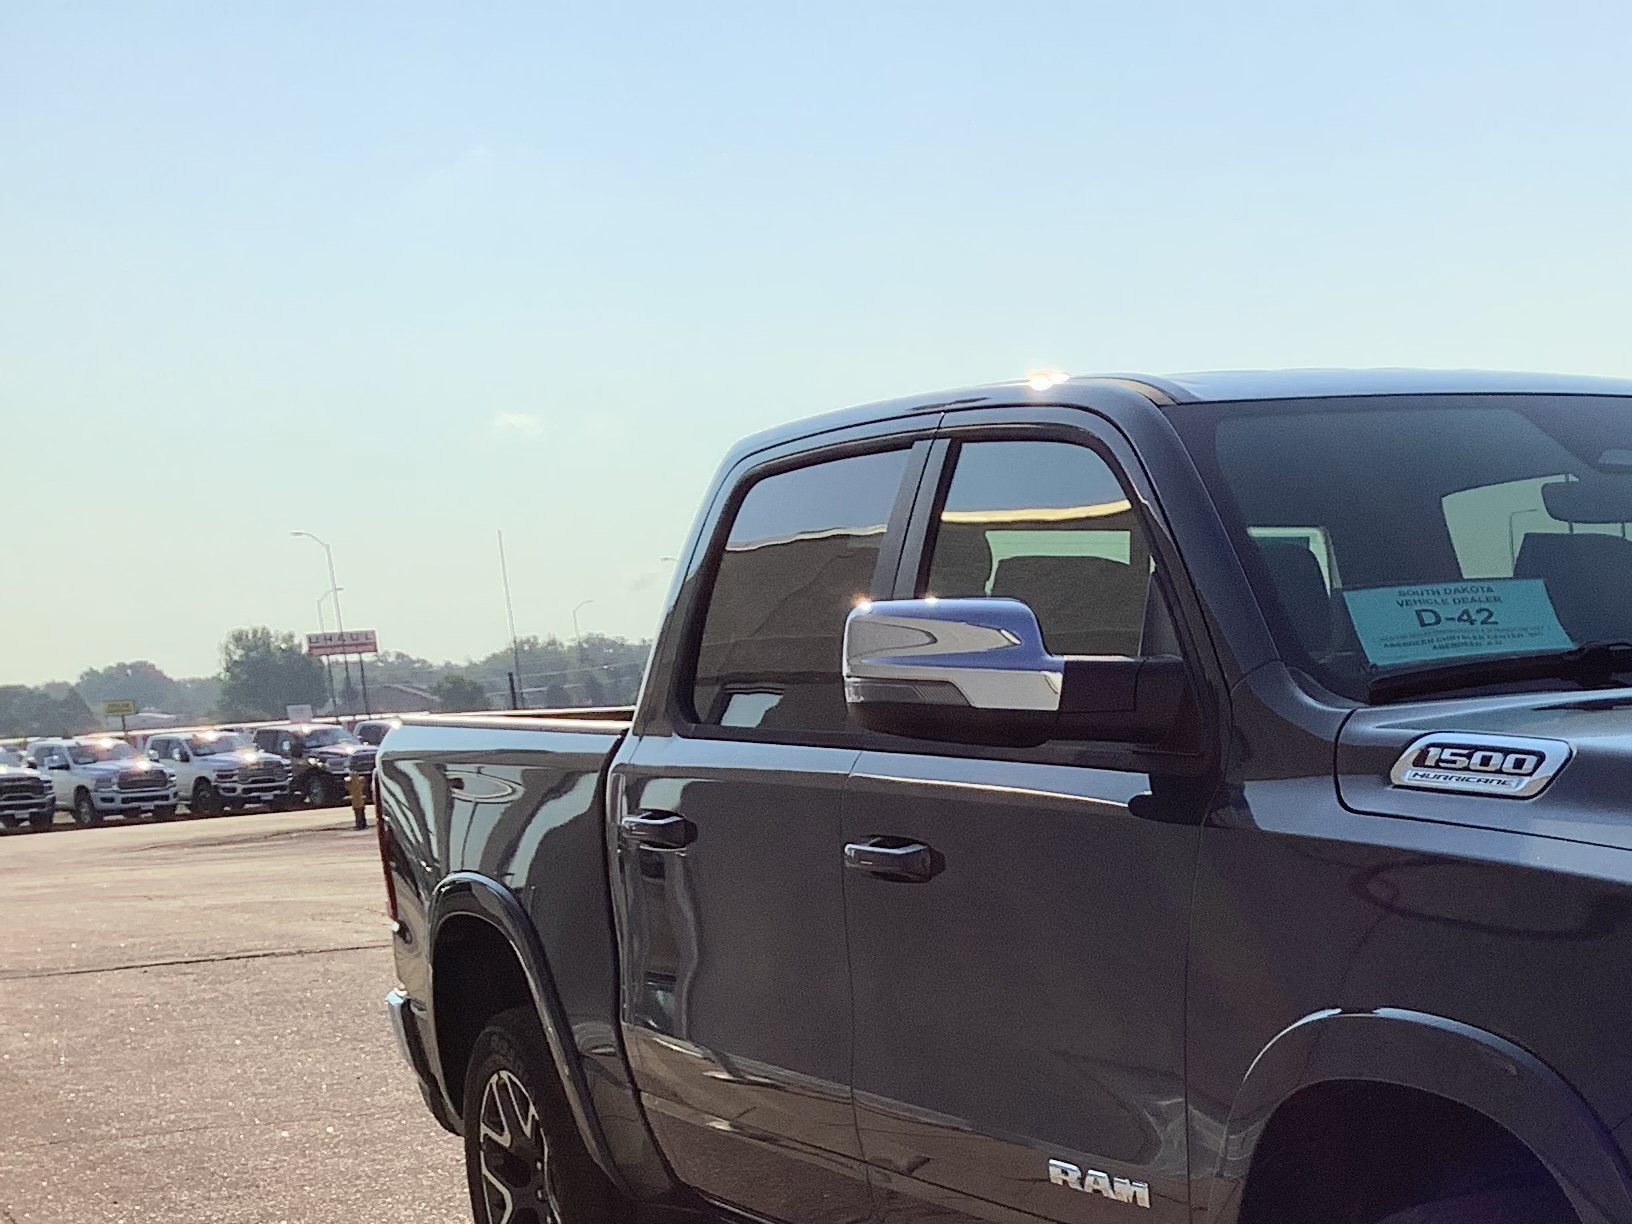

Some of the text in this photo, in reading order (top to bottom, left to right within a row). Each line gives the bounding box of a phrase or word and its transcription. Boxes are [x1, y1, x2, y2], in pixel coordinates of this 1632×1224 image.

[1397, 585, 1495, 597] SOUTH DAKOTA
[1396, 595, 1503, 607] VEHICLE DEALER
[1415, 608, 1499, 628] D-42
[1425, 746, 1538, 774] 1500
[1412, 771, 1516, 786] HURRICANE
[1048, 1159, 1150, 1208] RAM
